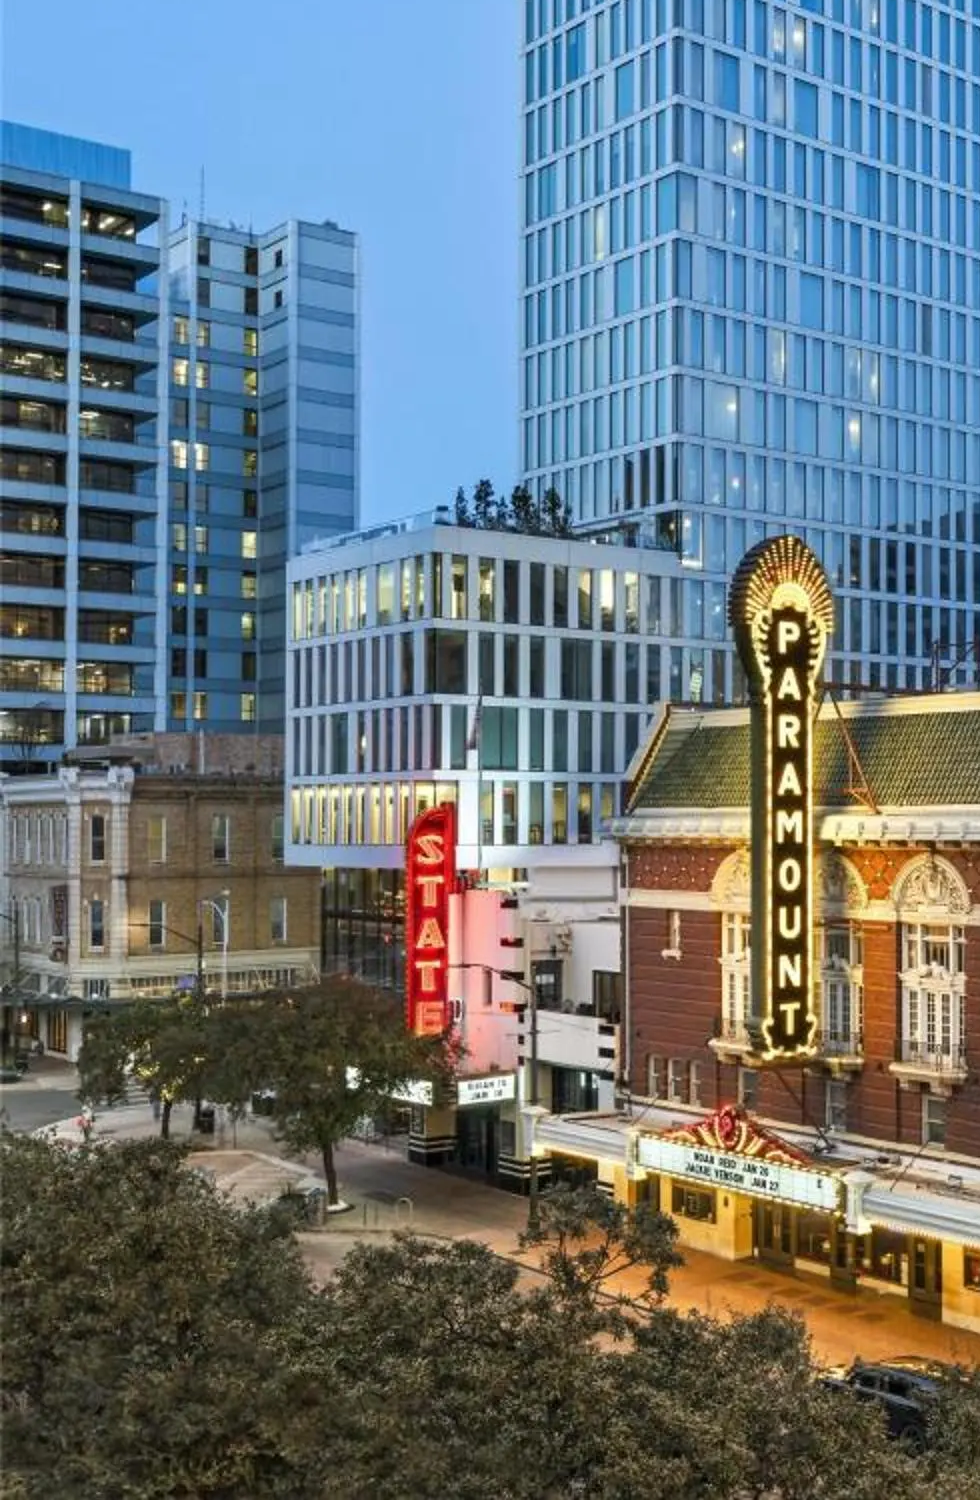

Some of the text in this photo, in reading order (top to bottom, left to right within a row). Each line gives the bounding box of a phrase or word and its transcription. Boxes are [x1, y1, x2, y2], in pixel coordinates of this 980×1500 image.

[776, 621, 803, 1035] PARAMOUNT
[415, 834, 445, 1034] STATE
[742, 1163, 758, 1174] JAN
[751, 1177, 767, 1189] JAN
